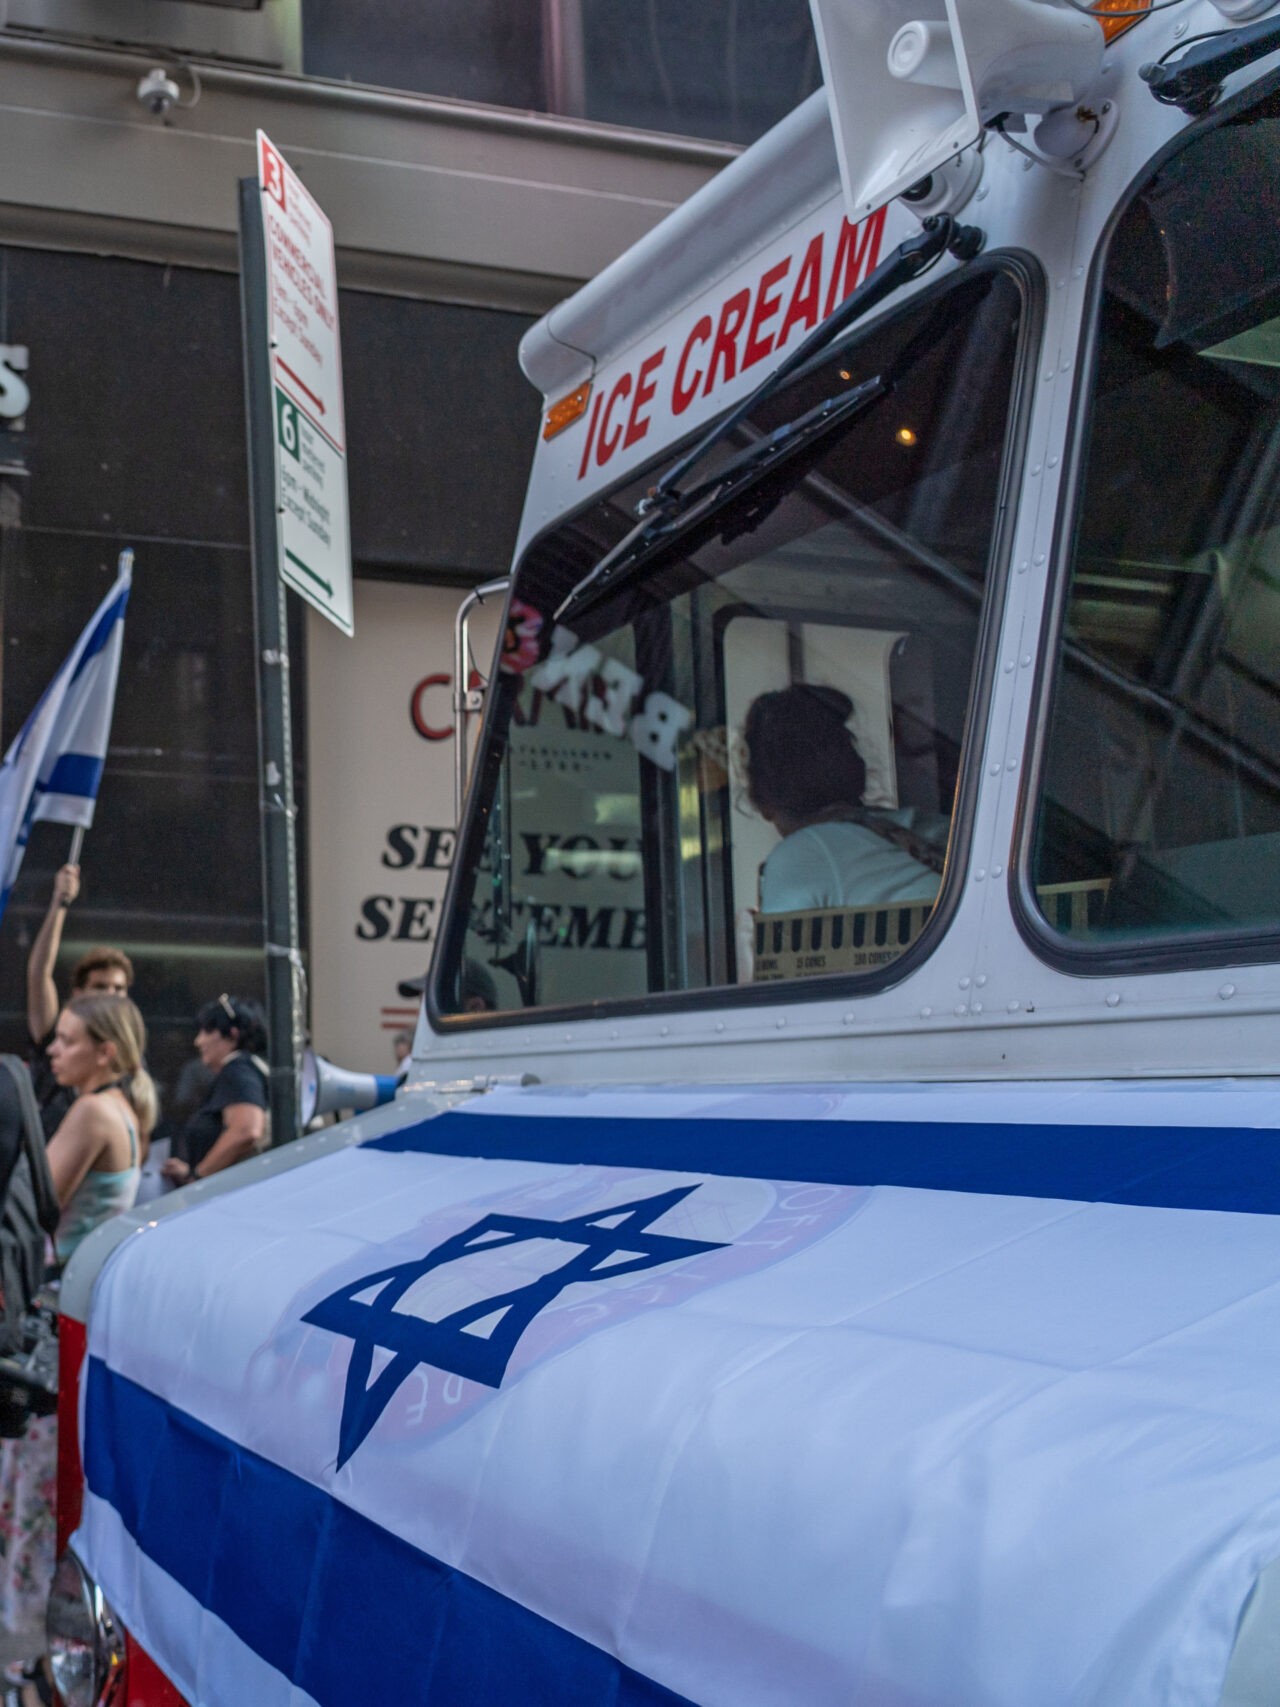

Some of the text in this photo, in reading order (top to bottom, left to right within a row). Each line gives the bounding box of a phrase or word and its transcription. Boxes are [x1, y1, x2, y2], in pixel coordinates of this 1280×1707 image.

[577, 202, 889, 481] ICE CREAM
[280, 402, 297, 452] 6
